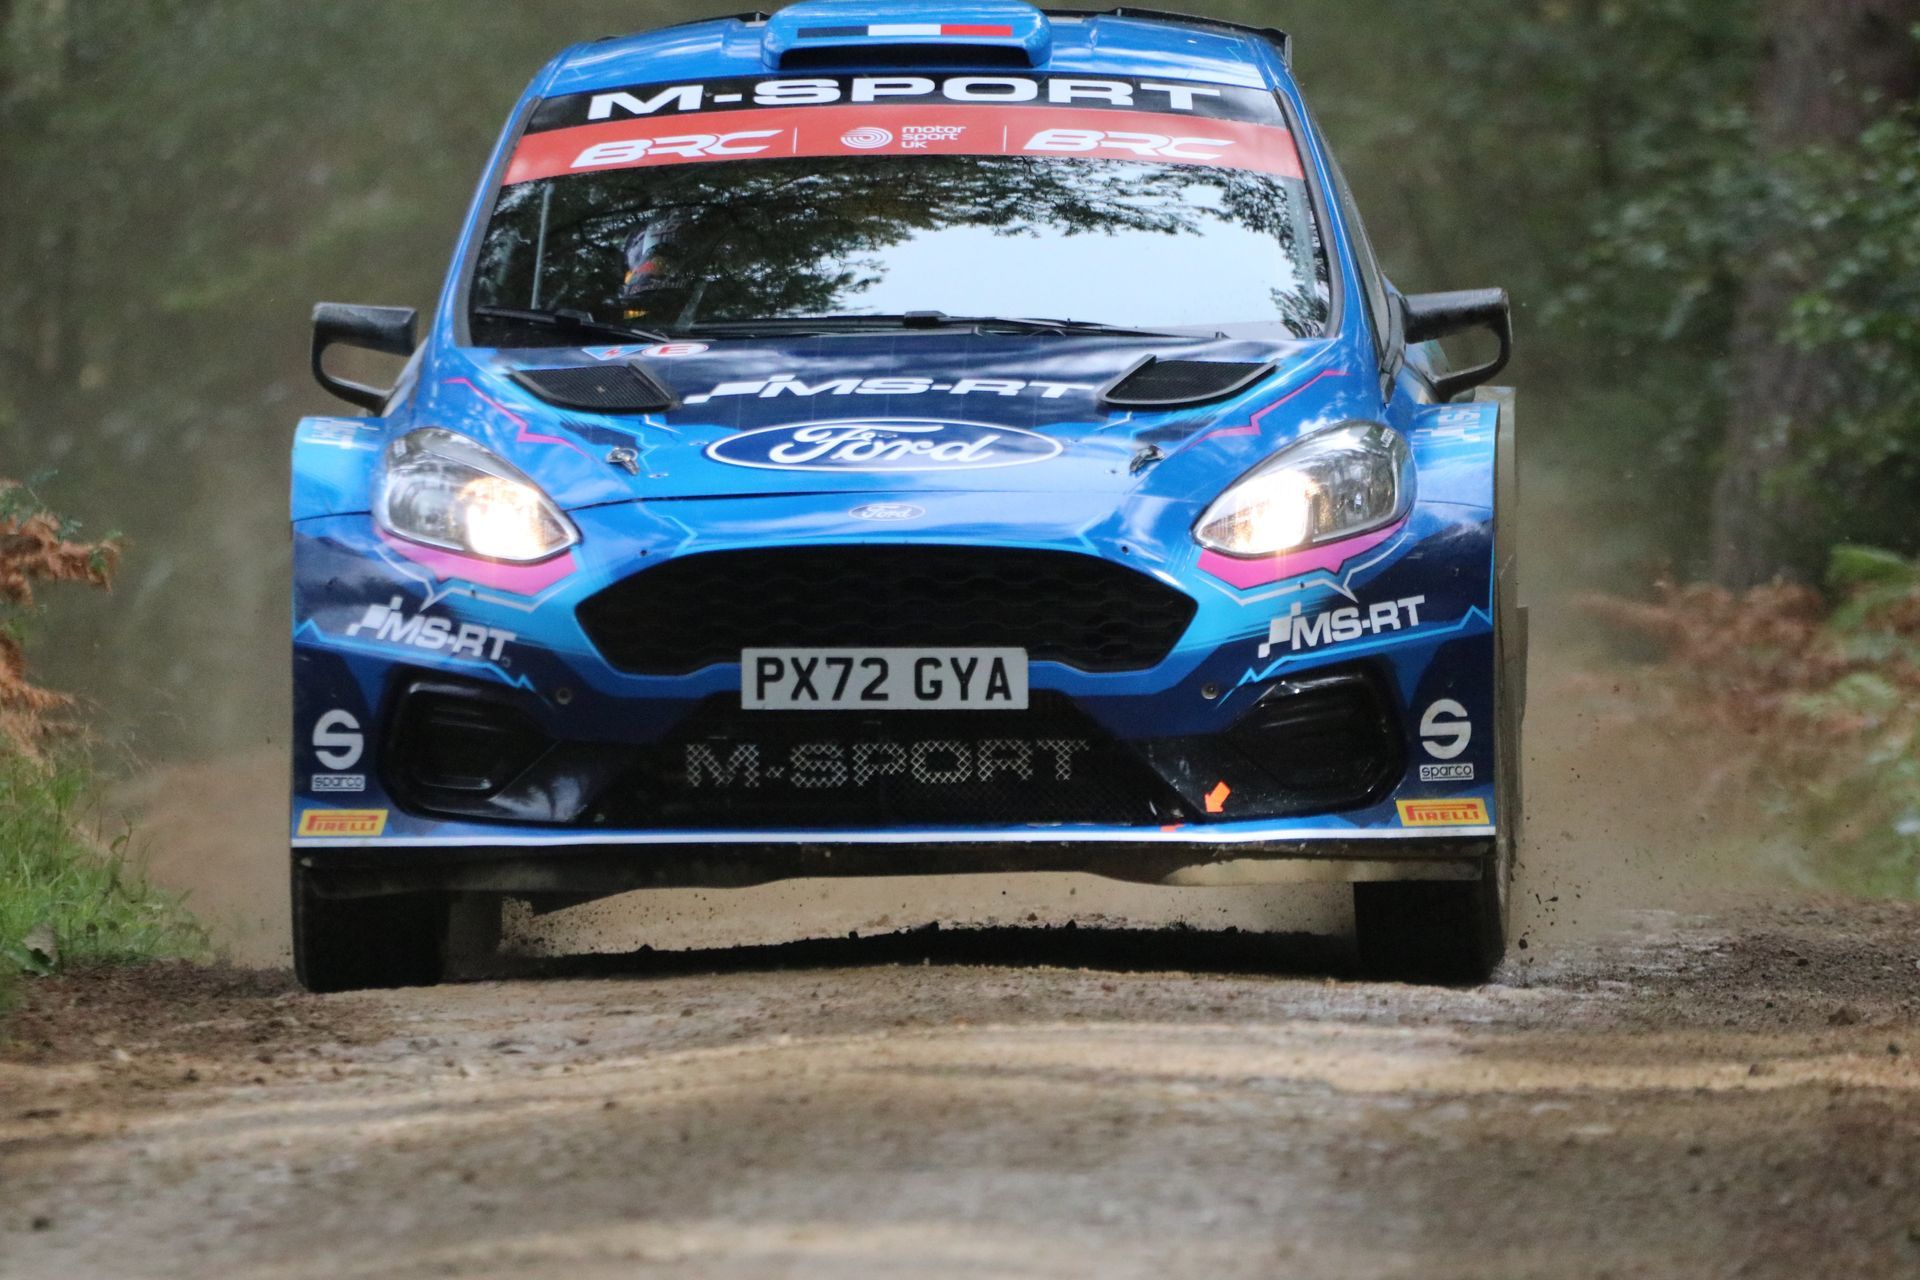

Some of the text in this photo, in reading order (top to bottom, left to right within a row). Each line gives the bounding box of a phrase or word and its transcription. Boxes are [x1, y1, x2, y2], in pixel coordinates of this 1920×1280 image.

[588, 76, 1221, 121] M-SPORT
[901, 125, 967, 134] motor
[901, 132, 958, 141] sport
[570, 129, 784, 168] BRC
[901, 140, 928, 149] UK
[1023, 128, 1237, 161] BRC
[758, 376, 1098, 399] MS-RT
[768, 425, 1001, 464] Ford
[861, 504, 913, 519] Ford
[1292, 595, 1426, 651] MS-RT
[376, 610, 518, 661] MS-RT
[756, 657, 1013, 702] PX72 GYA
[686, 738, 1091, 789] M-SPORT
[1421, 765, 1473, 780] sparco
[314, 776, 364, 789] sparco
[306, 815, 379, 832] PIRELLI
[1405, 803, 1479, 821] PIRELLI
